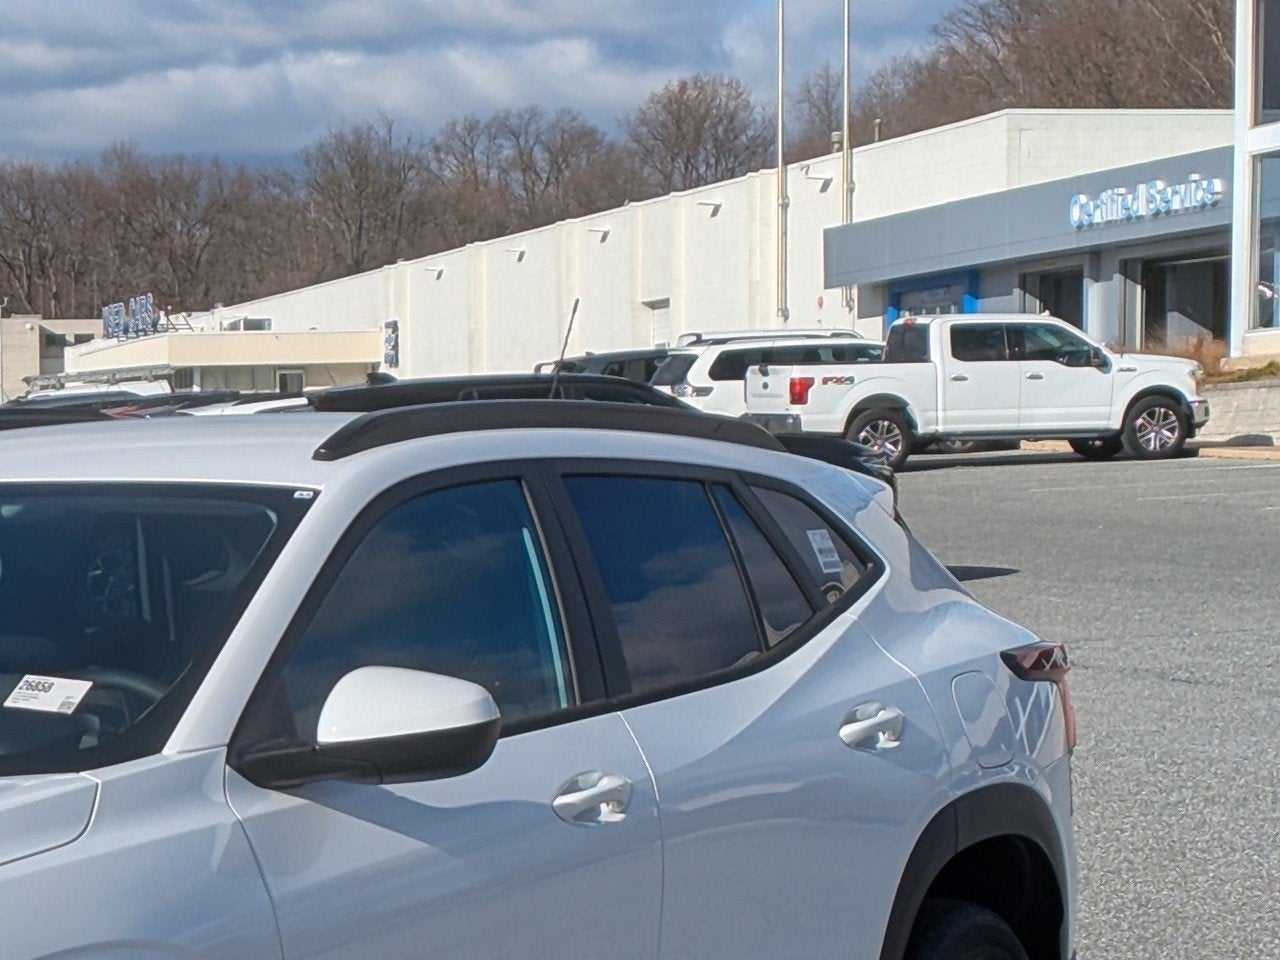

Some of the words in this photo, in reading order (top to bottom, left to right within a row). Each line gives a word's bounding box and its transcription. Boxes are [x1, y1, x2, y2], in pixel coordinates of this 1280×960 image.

[1070, 183, 1146, 228] Certified
[1147, 172, 1222, 216] Service
[822, 376, 855, 385] FX4
